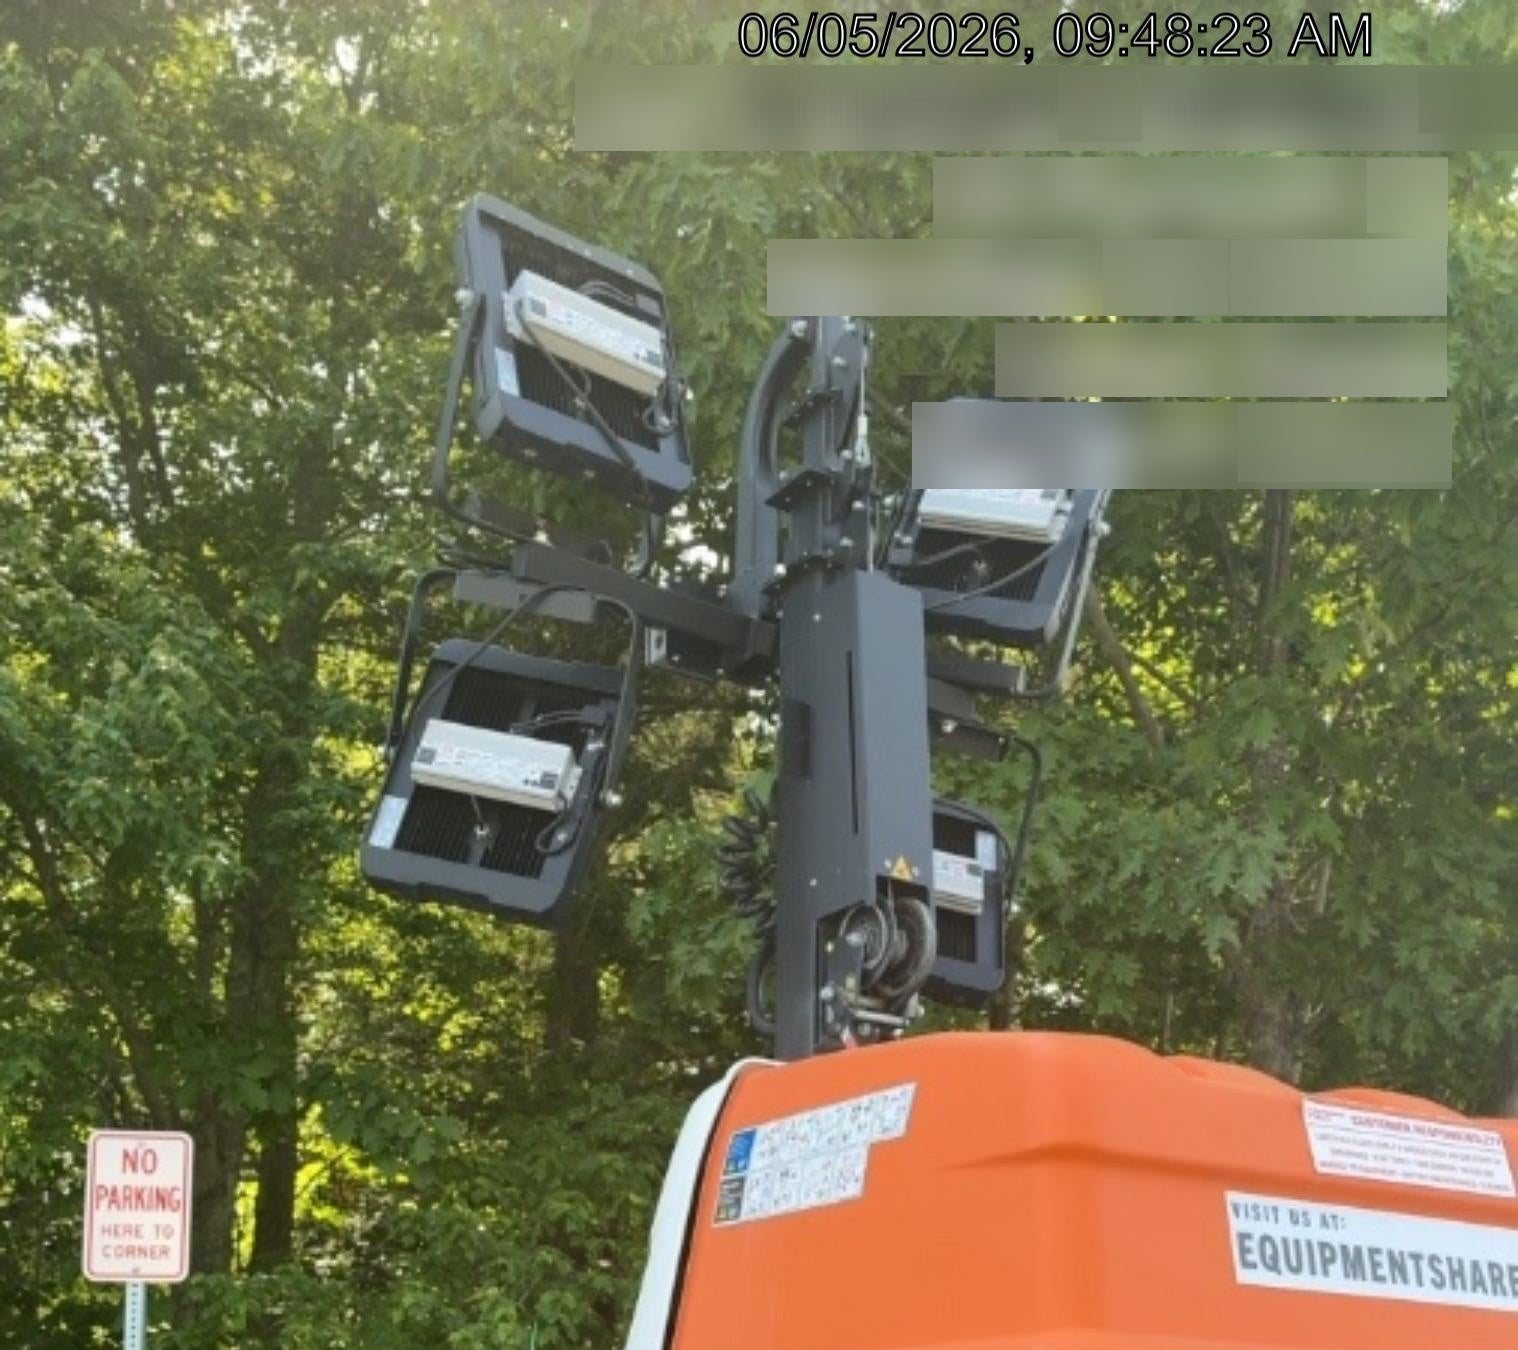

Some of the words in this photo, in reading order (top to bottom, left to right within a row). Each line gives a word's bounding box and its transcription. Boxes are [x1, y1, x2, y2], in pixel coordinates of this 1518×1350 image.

[122, 1148, 157, 1174] NO
[95, 1185, 181, 1212] PARKING
[1231, 1203, 1278, 1224] VISIT
[1289, 1208, 1311, 1227] US
[1319, 1213, 1347, 1231] AT:
[101, 1224, 145, 1239] HERE
[154, 1224, 175, 1239] TO
[102, 1244, 169, 1260] CORNER
